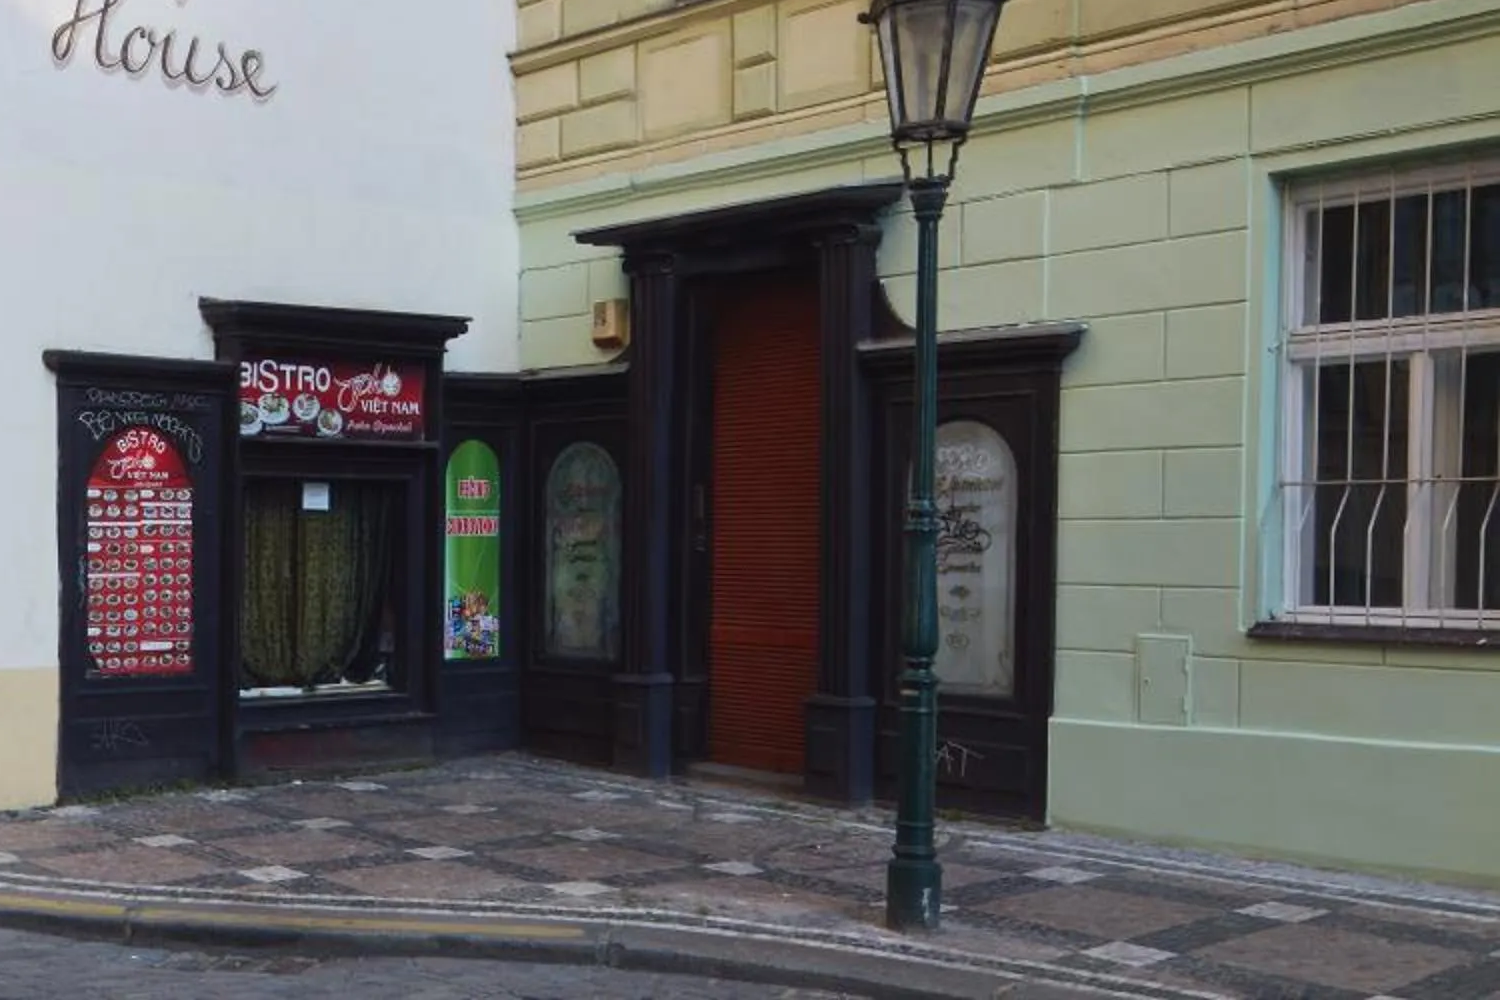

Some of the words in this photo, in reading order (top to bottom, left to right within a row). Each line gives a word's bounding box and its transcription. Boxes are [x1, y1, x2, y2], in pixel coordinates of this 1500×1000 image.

[240, 359, 331, 393] BISTRO
[391, 401, 420, 415] NAM
[116, 429, 166, 455] BISTRO
